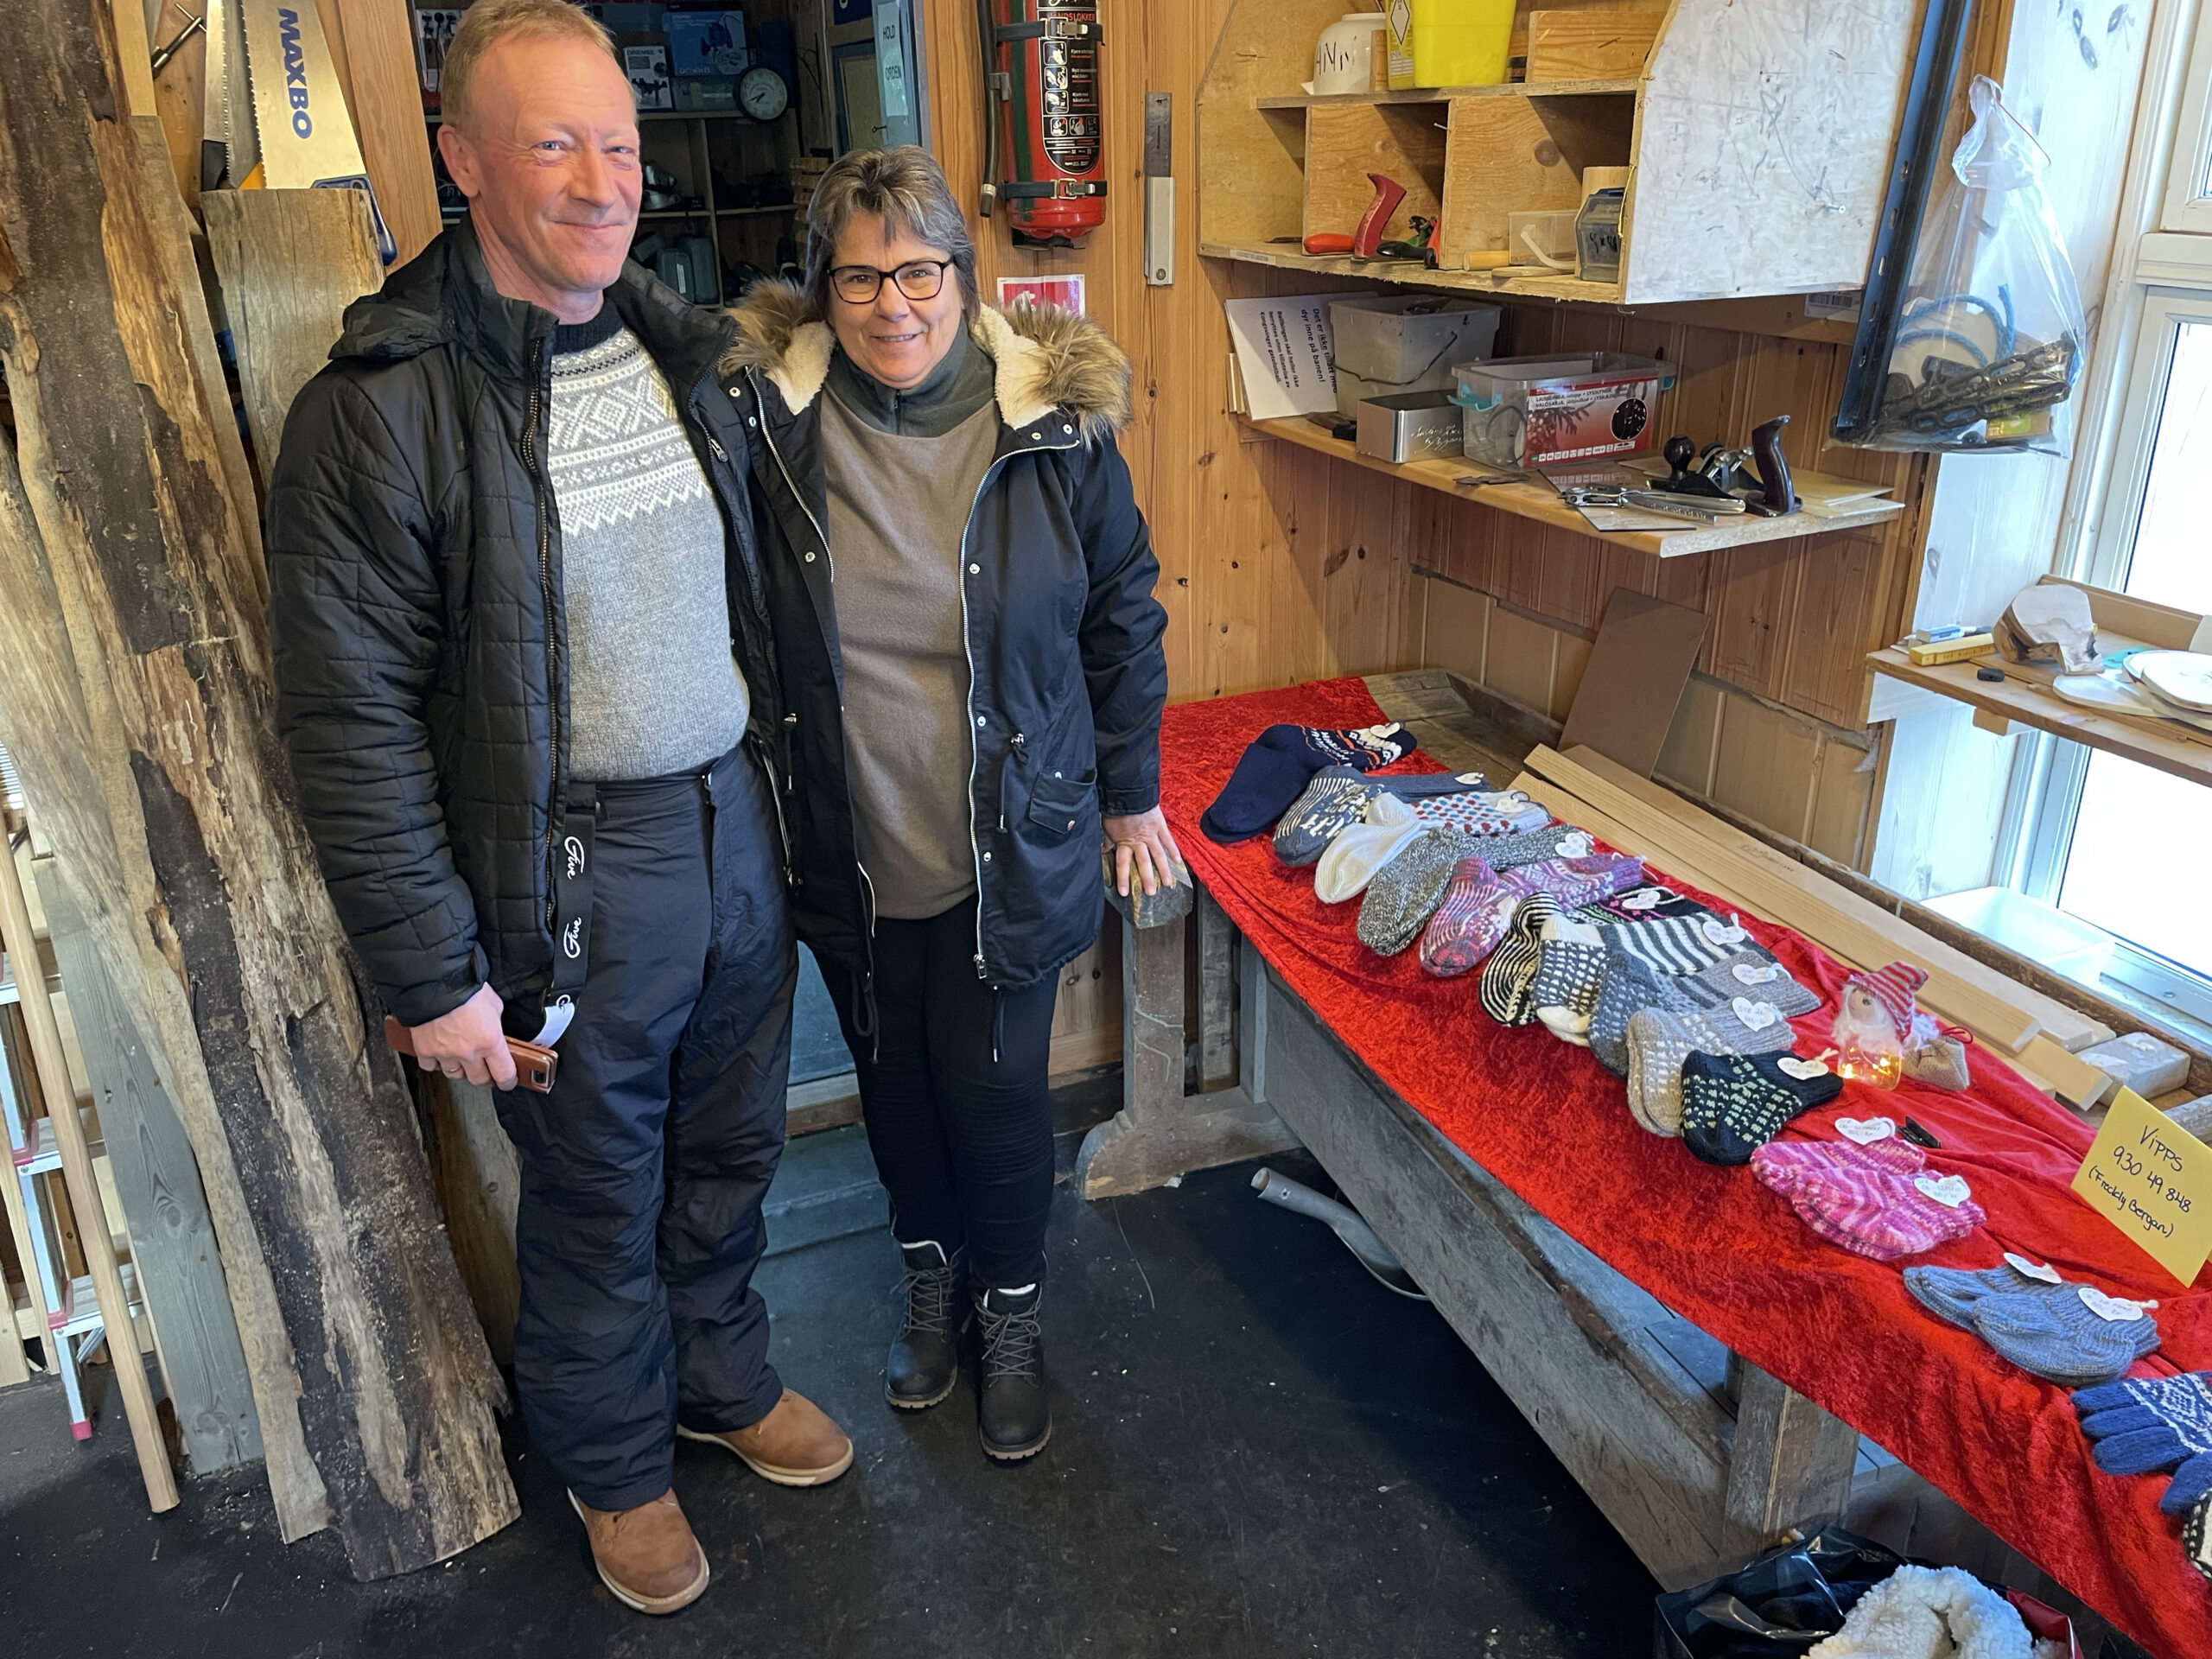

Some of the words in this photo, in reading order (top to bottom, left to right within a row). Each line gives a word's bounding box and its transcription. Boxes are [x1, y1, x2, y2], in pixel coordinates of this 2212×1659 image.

[882, 25, 895, 40] HOLD
[276, 8, 313, 139] MAXBO
[1260, 311, 1273, 348] Kongsvinger
[1305, 323, 1313, 341] inne
[1317, 322, 1325, 334] er
[1309, 343, 1319, 353] på
[1319, 334, 1328, 351] ikke
[1313, 354, 1325, 383] banen!
[1285, 380, 1291, 389] av
[564, 836, 585, 880] Five
[2088, 1165, 2126, 1211] (Freddy
[2113, 1146, 2143, 1176] 930
[2146, 1171, 2164, 1194] 49
[2165, 1187, 2192, 1213] 848
